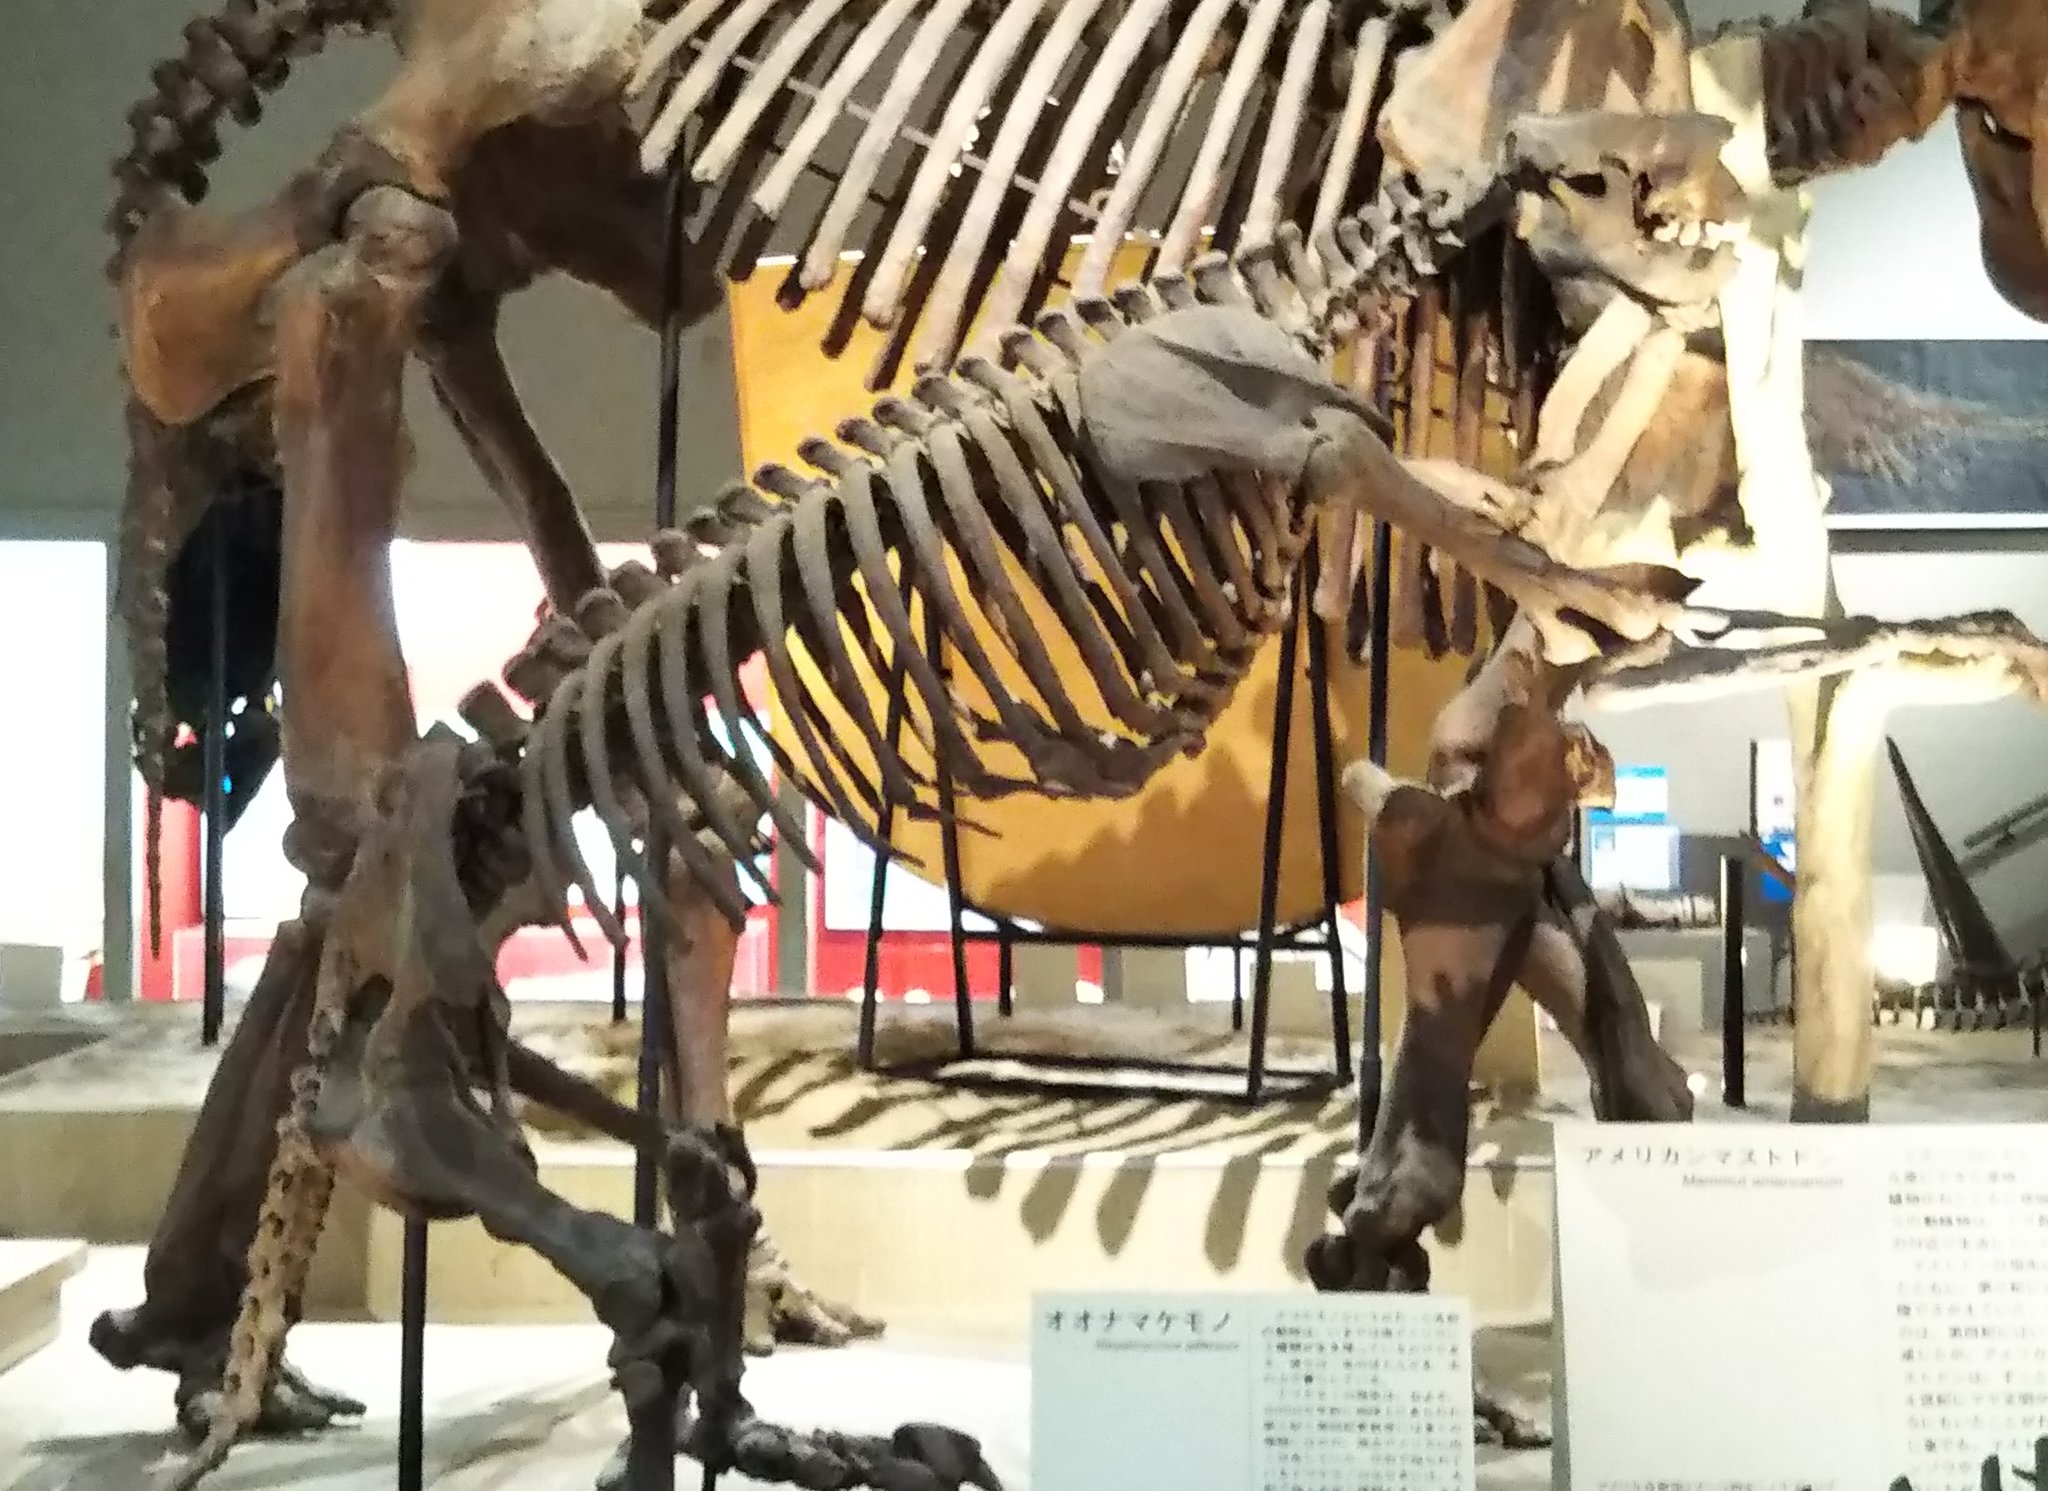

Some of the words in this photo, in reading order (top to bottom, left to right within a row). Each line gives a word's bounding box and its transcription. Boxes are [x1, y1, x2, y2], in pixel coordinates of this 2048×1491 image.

[1046, 1309, 1231, 1334] オオナマケモノ
